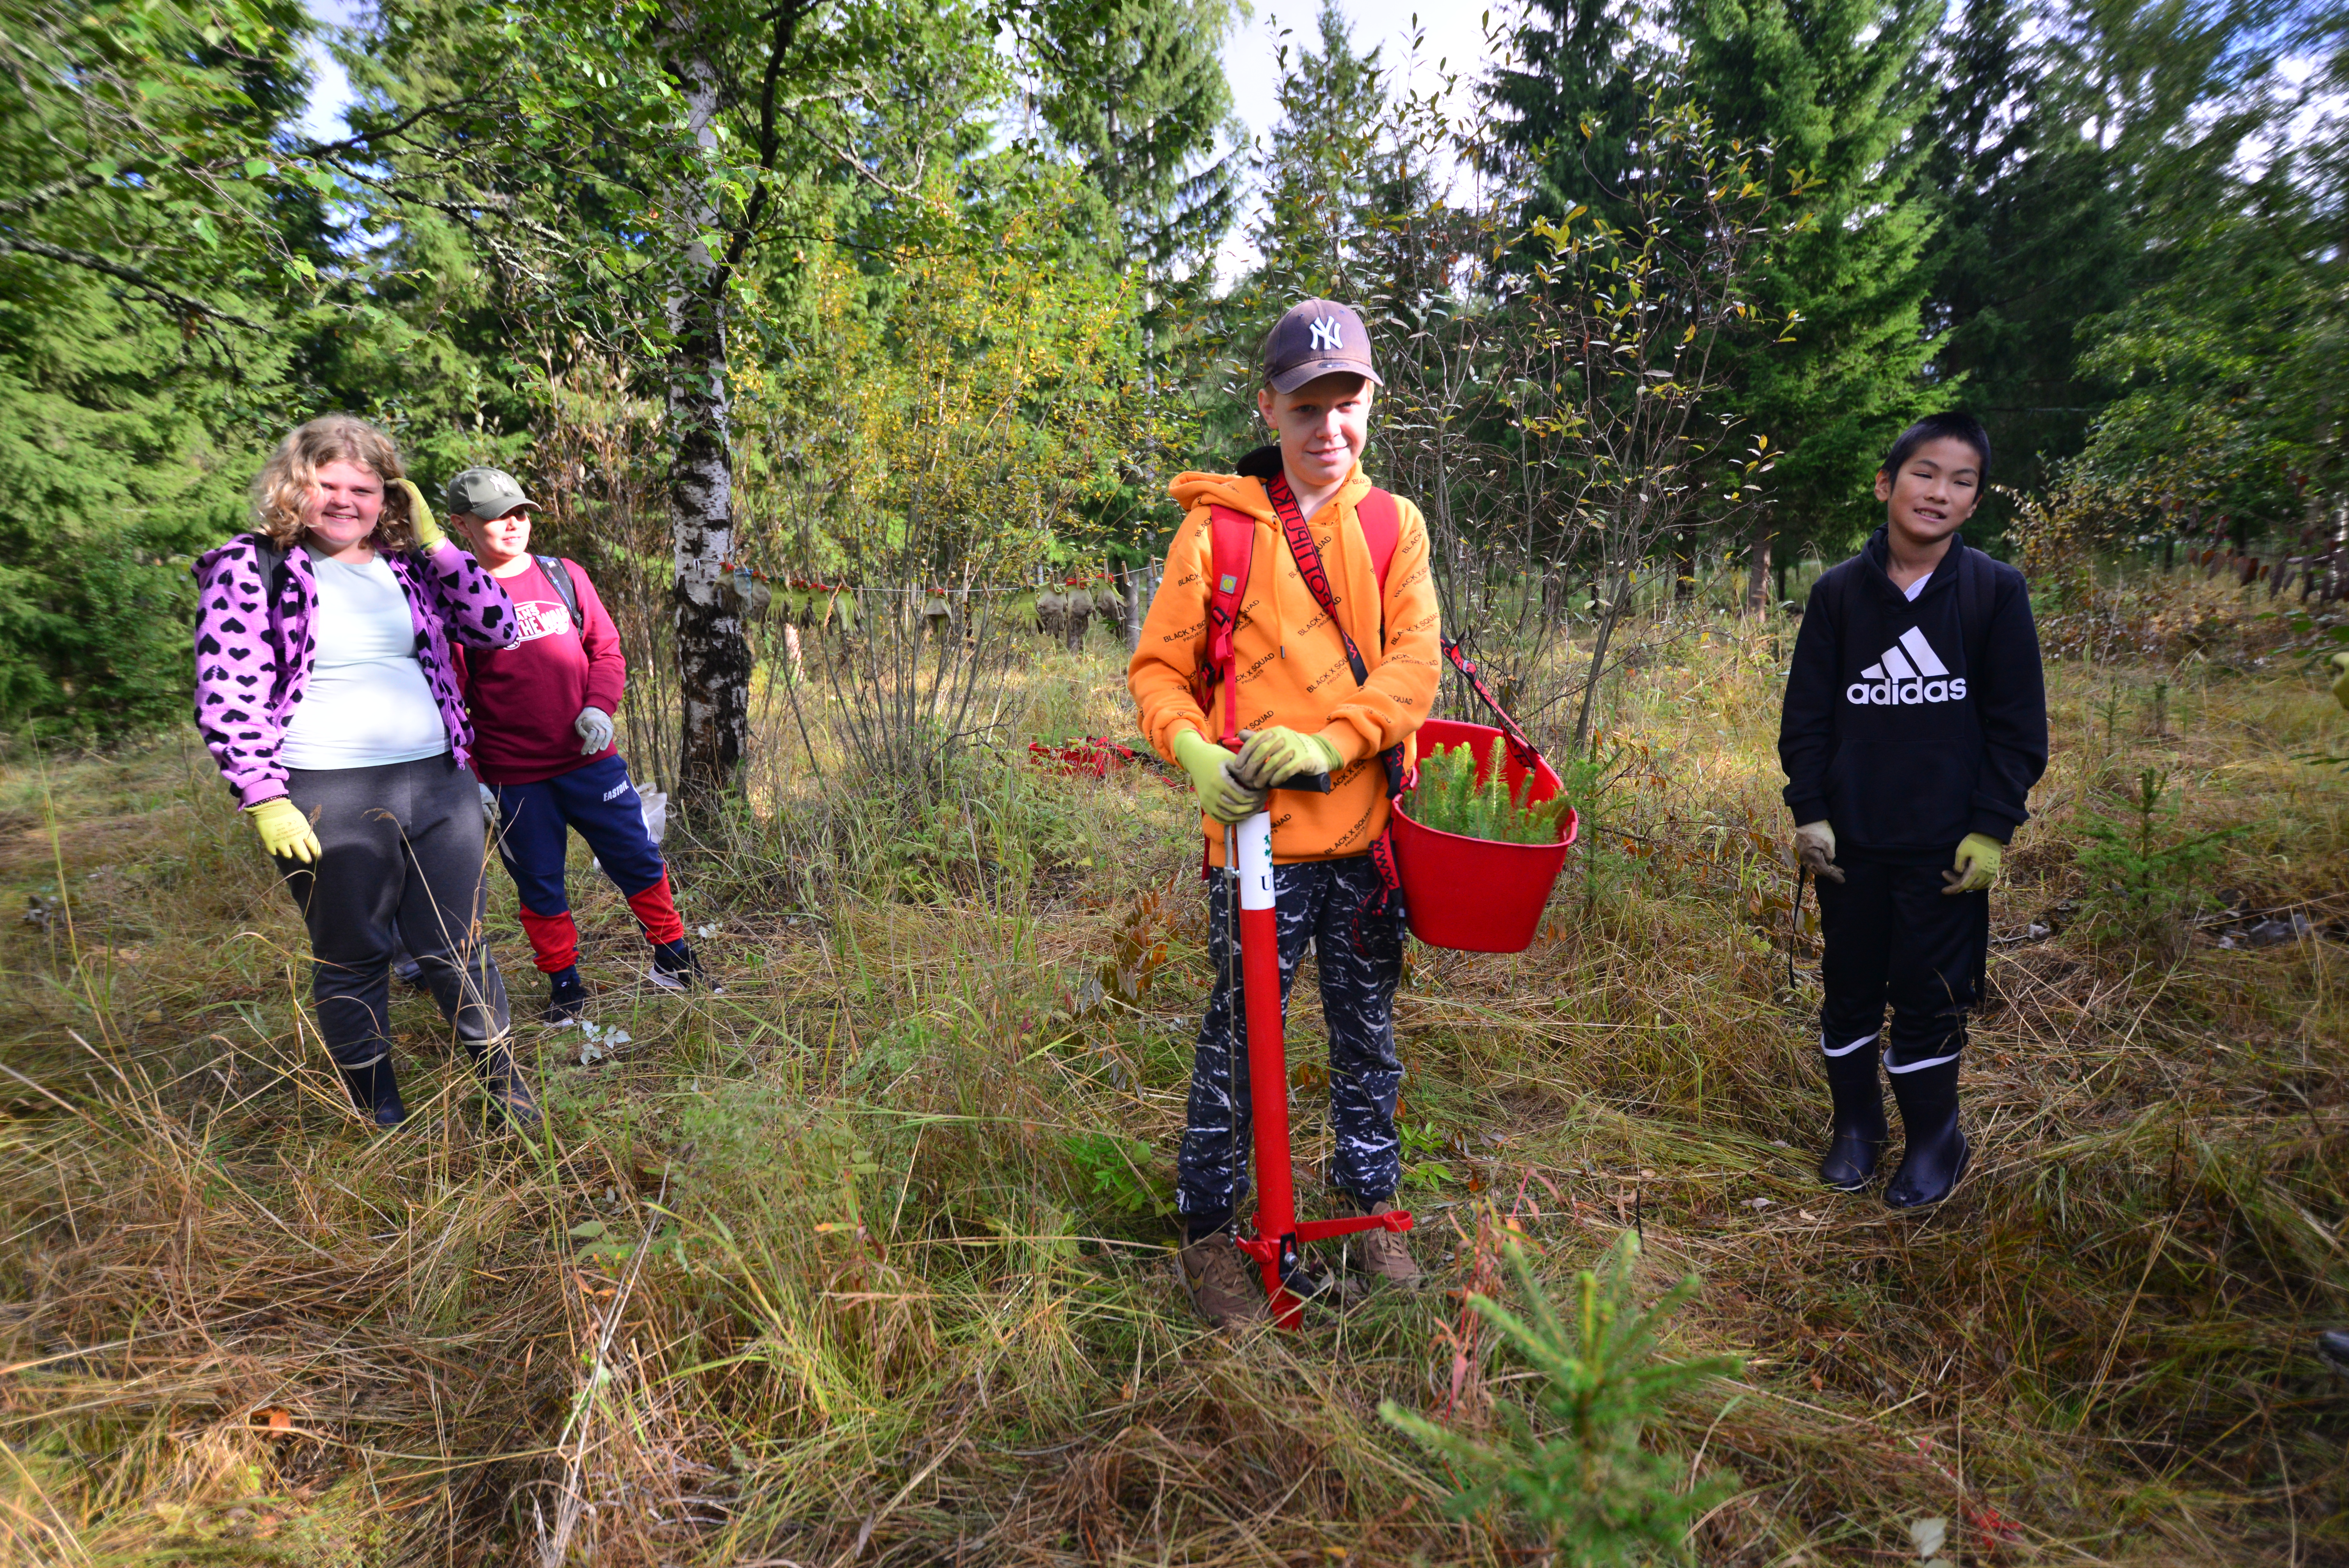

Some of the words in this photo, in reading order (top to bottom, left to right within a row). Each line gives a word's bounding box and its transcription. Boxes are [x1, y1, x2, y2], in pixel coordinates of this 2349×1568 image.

[1309, 316, 1343, 350] NY
[490, 474, 513, 491] NY
[1394, 574, 1417, 597] BLACK
[1163, 629, 1189, 643] BLACK
[1298, 616, 1321, 636] BLACK
[1251, 653, 1274, 672] SQUAD
[1241, 669, 1264, 684] PROJECTS
[1306, 672, 1330, 693] BLACK
[1847, 677, 1966, 705] adidas
[1249, 711, 1274, 729] SQUAD
[1344, 766, 1366, 786] PROJECTS
[604, 780, 629, 802] EASTDIV.
[1324, 834, 1349, 854] BLACK
